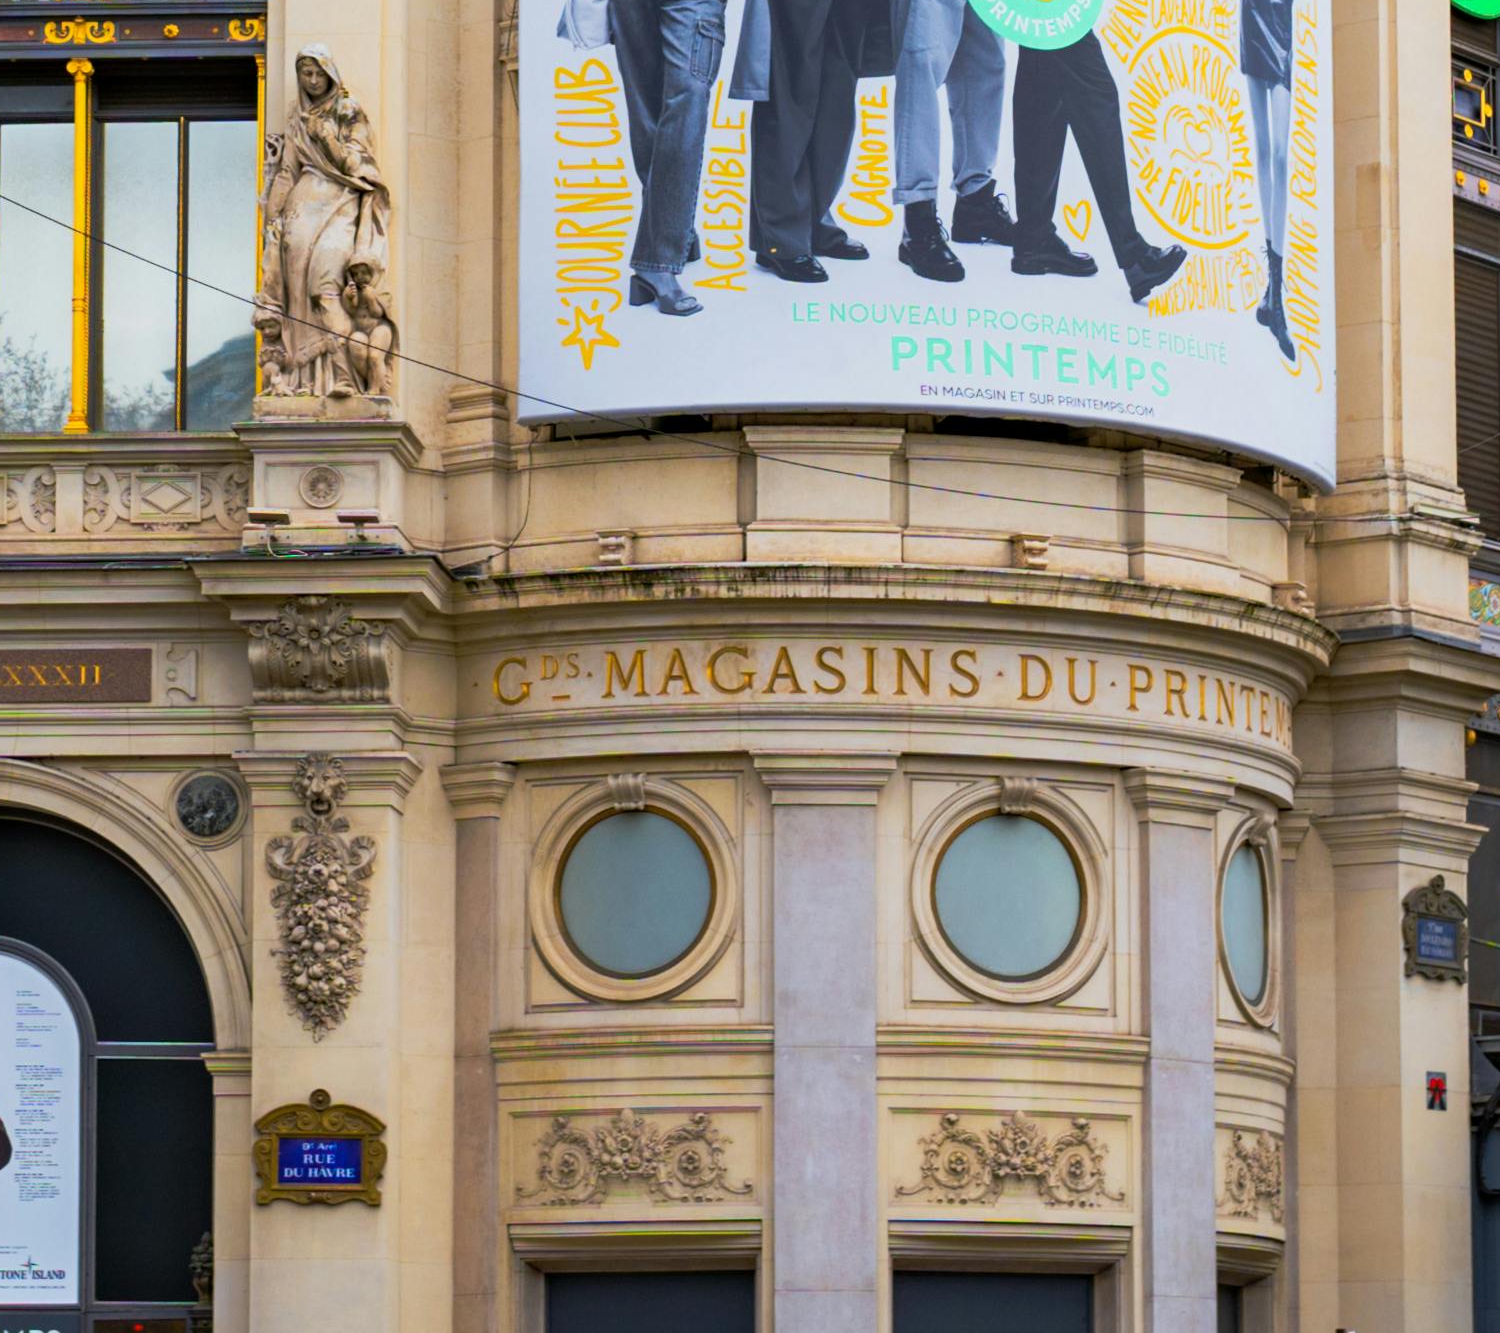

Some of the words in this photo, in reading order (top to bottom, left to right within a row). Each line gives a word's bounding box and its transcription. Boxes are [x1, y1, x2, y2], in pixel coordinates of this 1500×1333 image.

[554, 55, 624, 149] CLUB
[837, 84, 894, 228] CAGNOTTE
[1139, 157, 1163, 195] DE
[692, 79, 750, 293] ACCESSIBLE
[792, 302, 820, 323] LE
[829, 303, 957, 327] NOUVEAU
[967, 308, 1121, 344] PROGRAMME
[1128, 326, 1152, 348] DE
[891, 335, 1172, 398] PRINTEMPS
[920, 384, 938, 397] EN
[942, 385, 1007, 402] MAGASIN
[1010, 390, 1025, 402] ET
[1029, 392, 1055, 406] SUR
[1057, 394, 1156, 418] PRINTEMPS.COM
[601, 645, 982, 703] MAGASINS
[1017, 653, 1098, 707] DU
[283, 1167, 304, 1179] DU
[303, 1153, 336, 1165] RUE
[31, 1269, 66, 1280] ISLAND
